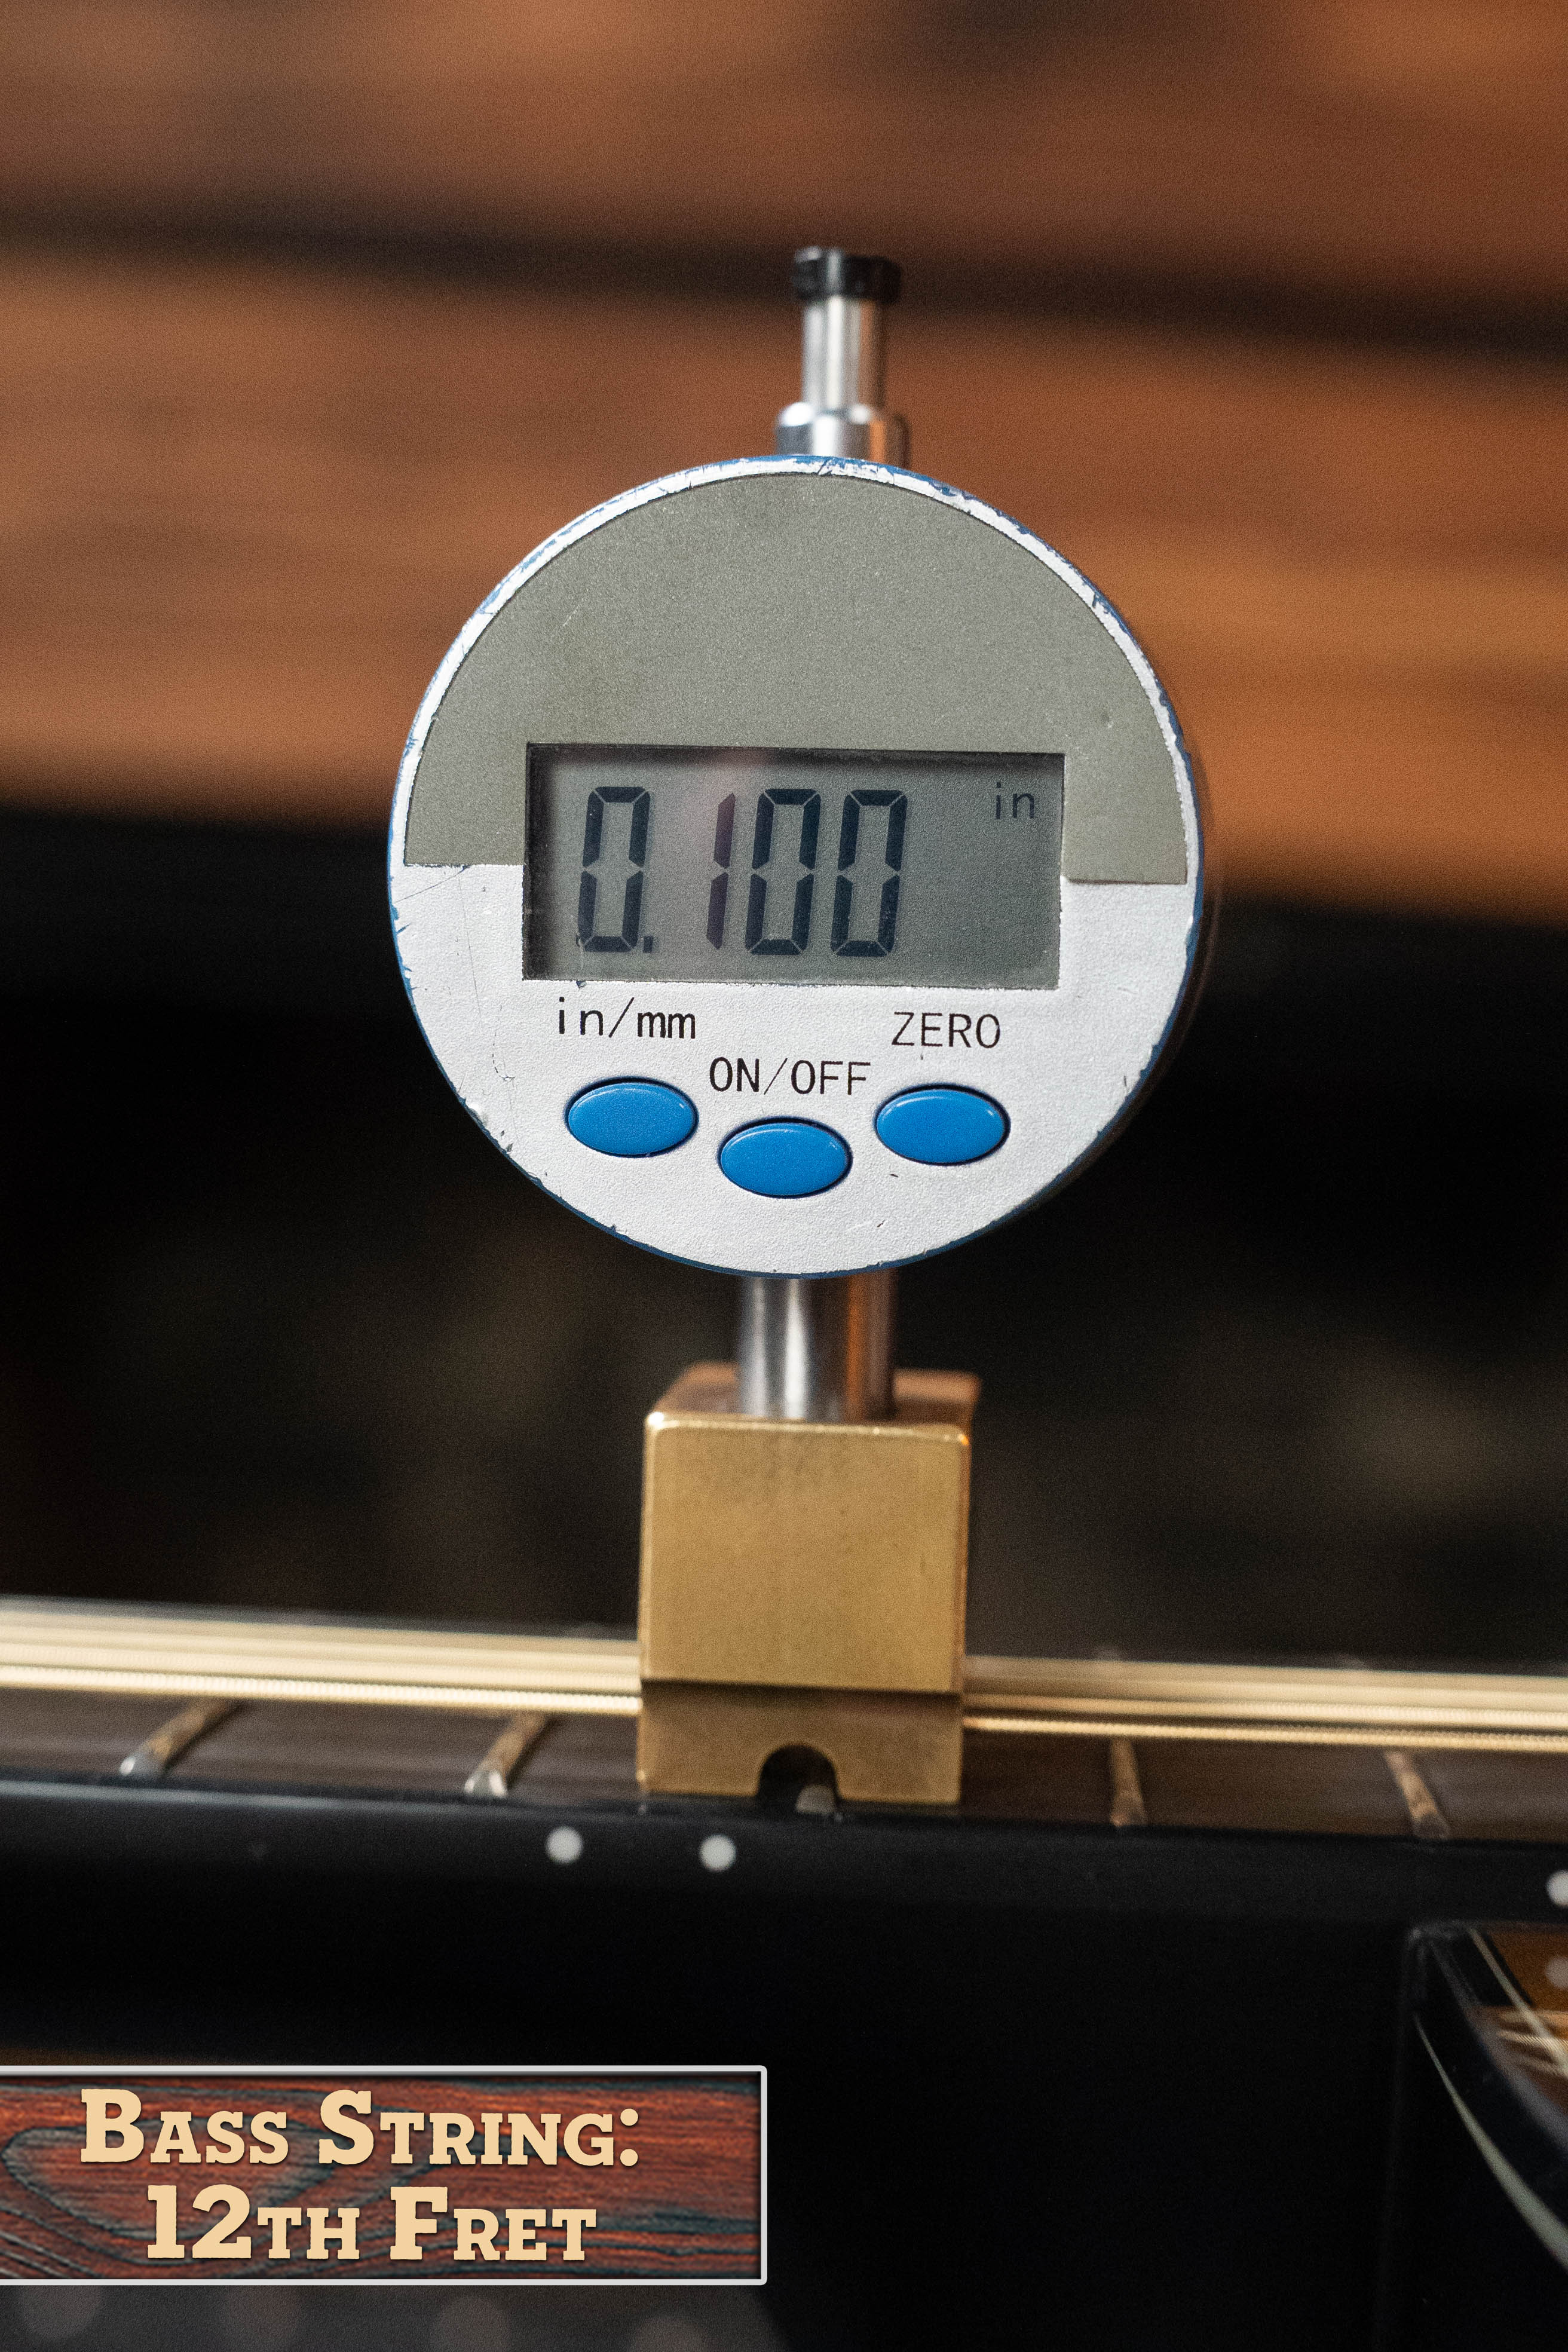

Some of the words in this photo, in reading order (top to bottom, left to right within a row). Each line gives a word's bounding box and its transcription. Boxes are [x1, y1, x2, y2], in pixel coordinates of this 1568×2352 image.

[577, 786, 908, 956] 0.100
[994, 782, 1036, 820] in
[558, 996, 696, 1040] in/mm
[891, 1011, 1001, 1049] ZERO
[709, 1056, 871, 1096] ON/OFF
